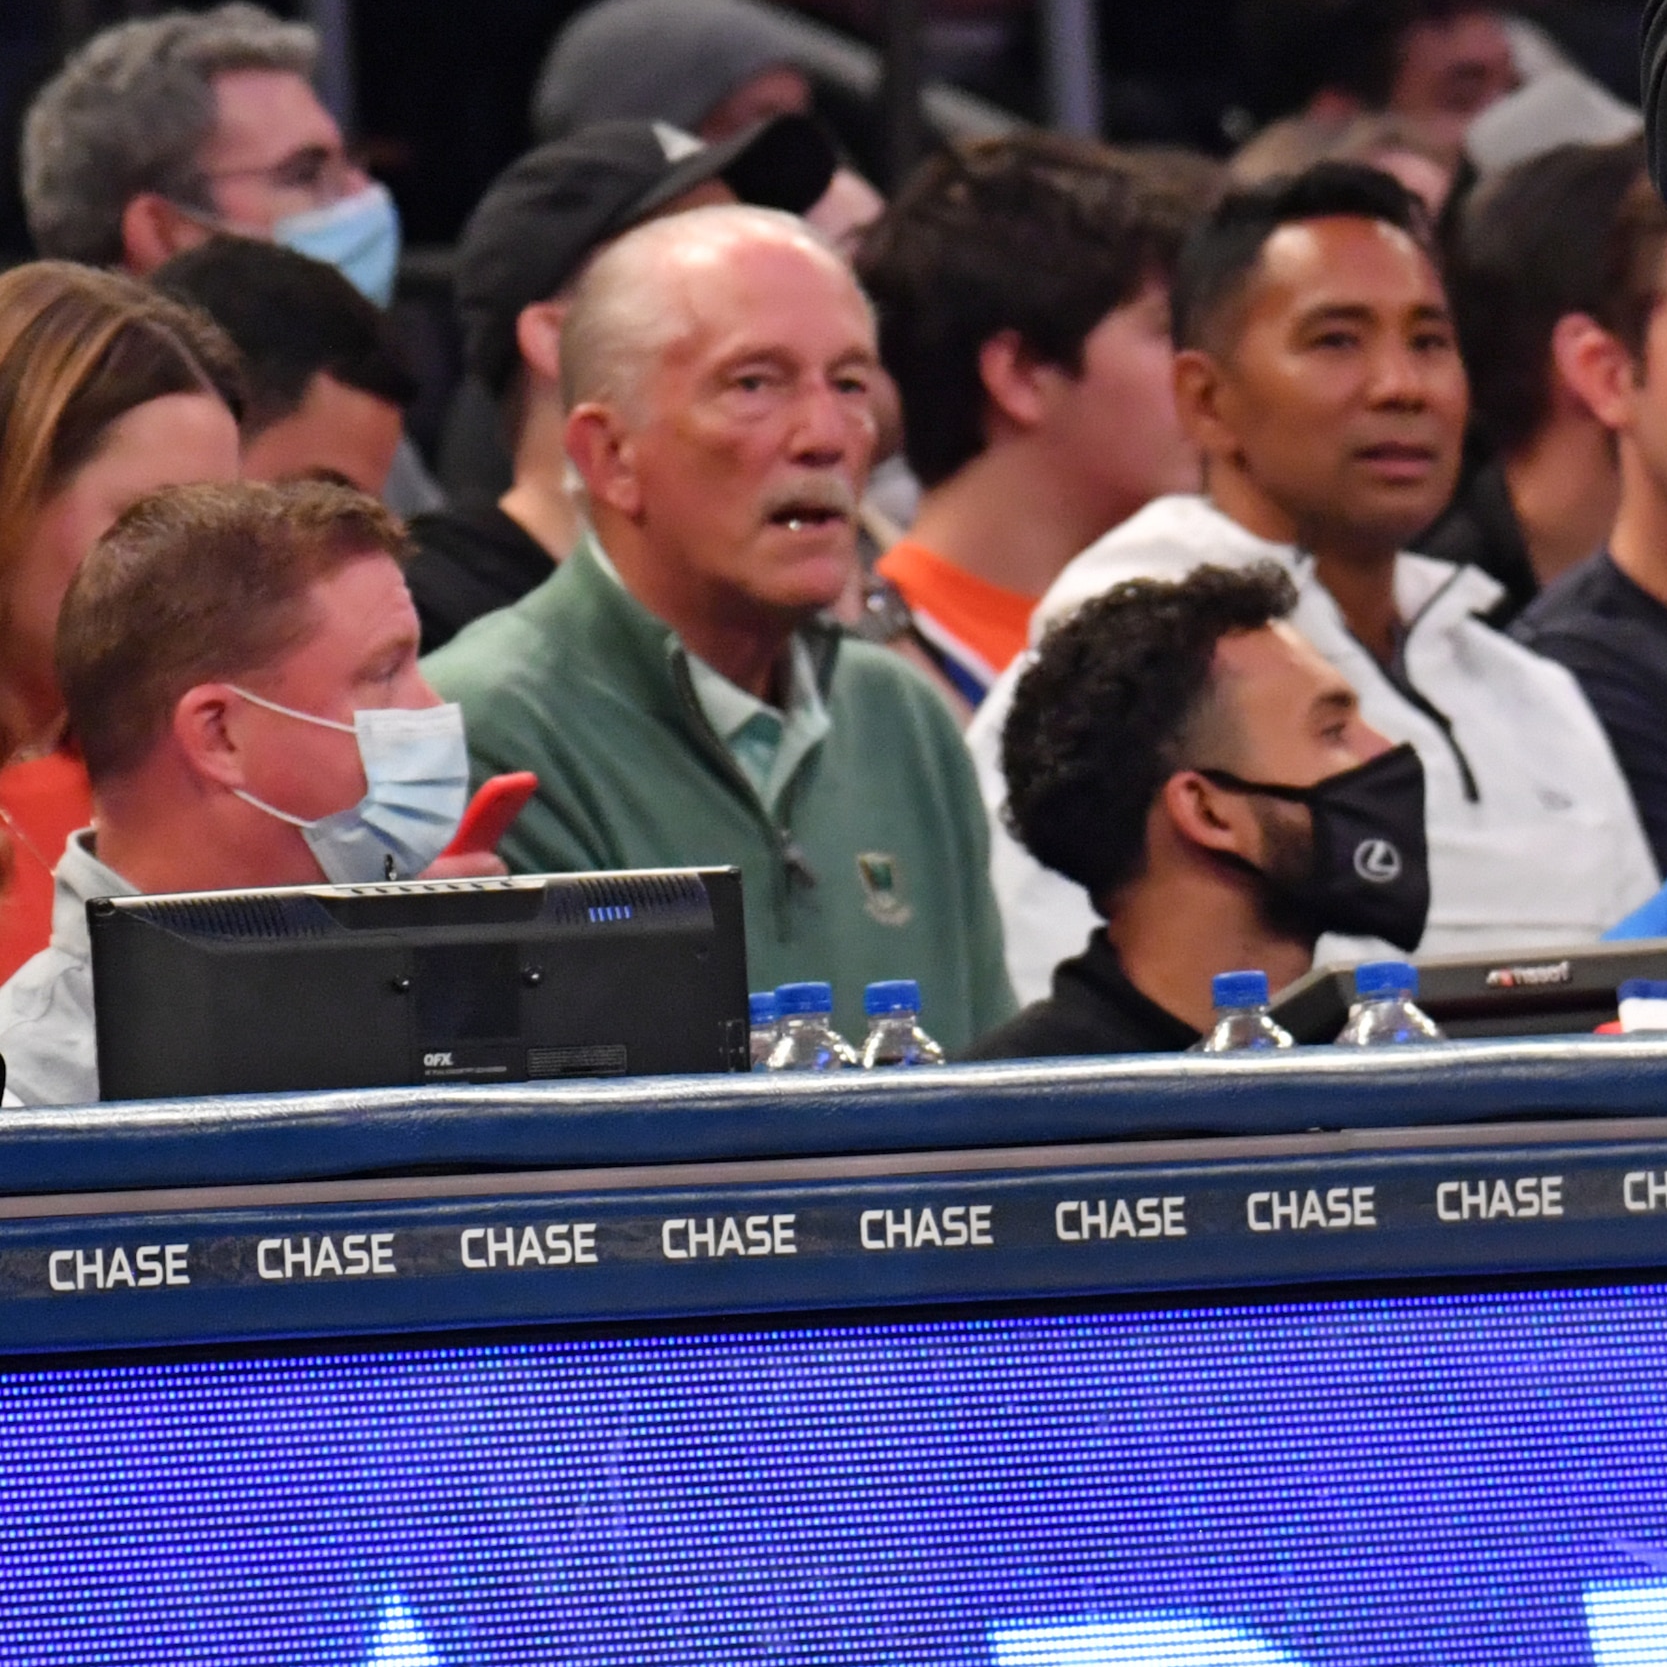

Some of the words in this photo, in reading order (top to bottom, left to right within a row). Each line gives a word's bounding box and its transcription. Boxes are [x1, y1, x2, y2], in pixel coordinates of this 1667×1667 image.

[49, 1244, 190, 1291] CHASE
[257, 1233, 396, 1279] CHASE
[460, 1223, 598, 1269] CHASE
[661, 1214, 797, 1259] CHASE
[860, 1205, 993, 1250] CHASE
[1055, 1196, 1187, 1241] CHASE
[1246, 1186, 1377, 1231] CHASE
[1436, 1176, 1565, 1221] CHASE
